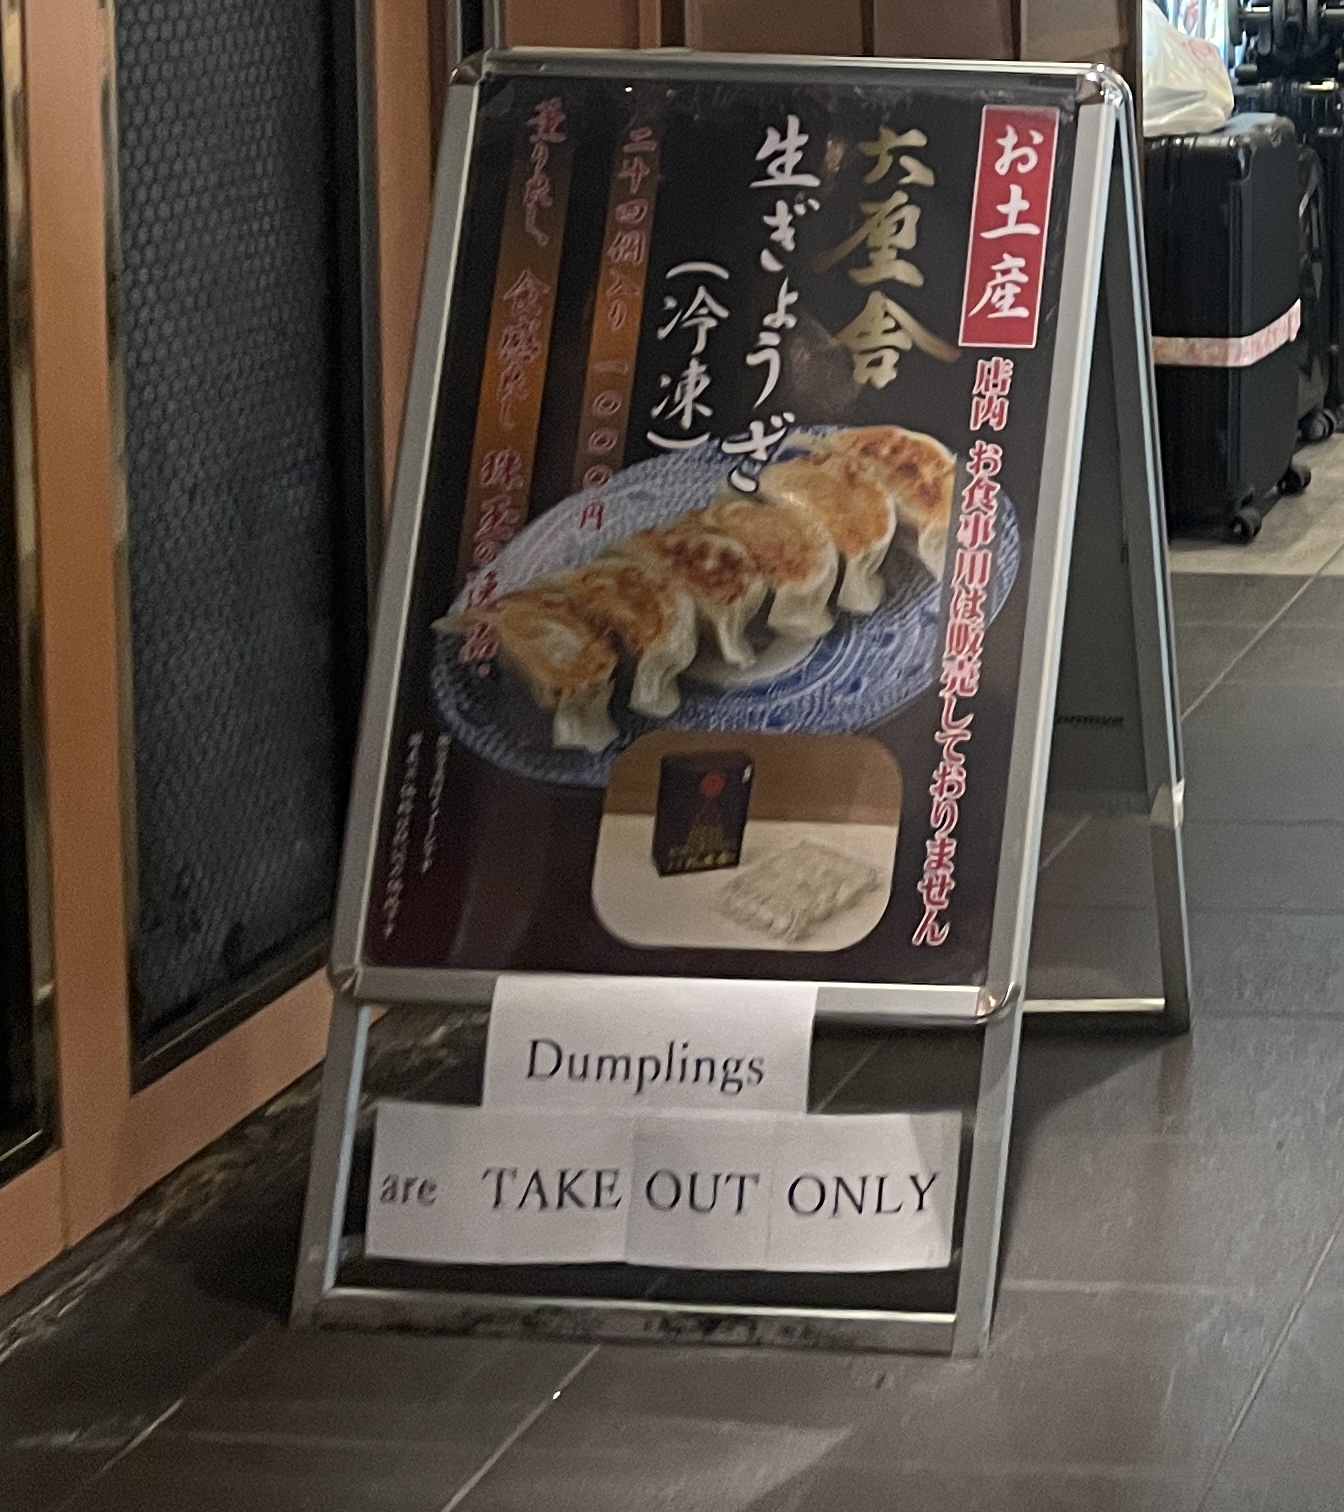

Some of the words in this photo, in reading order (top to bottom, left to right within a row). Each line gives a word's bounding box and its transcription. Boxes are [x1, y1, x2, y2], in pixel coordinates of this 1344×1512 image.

[968, 126, 1045, 320] お土産
[722, 114, 821, 492] 生ぎょうざ
[969, 357, 1013, 430] 店内
[912, 440, 1003, 945] お食事用は販売しておりません
[525, 1038, 766, 1095] Dumplings
[379, 1170, 438, 1208] are
[481, 1166, 623, 1212] TAKE
[644, 1171, 762, 1217] OUT
[786, 1171, 942, 1221] ONLY
